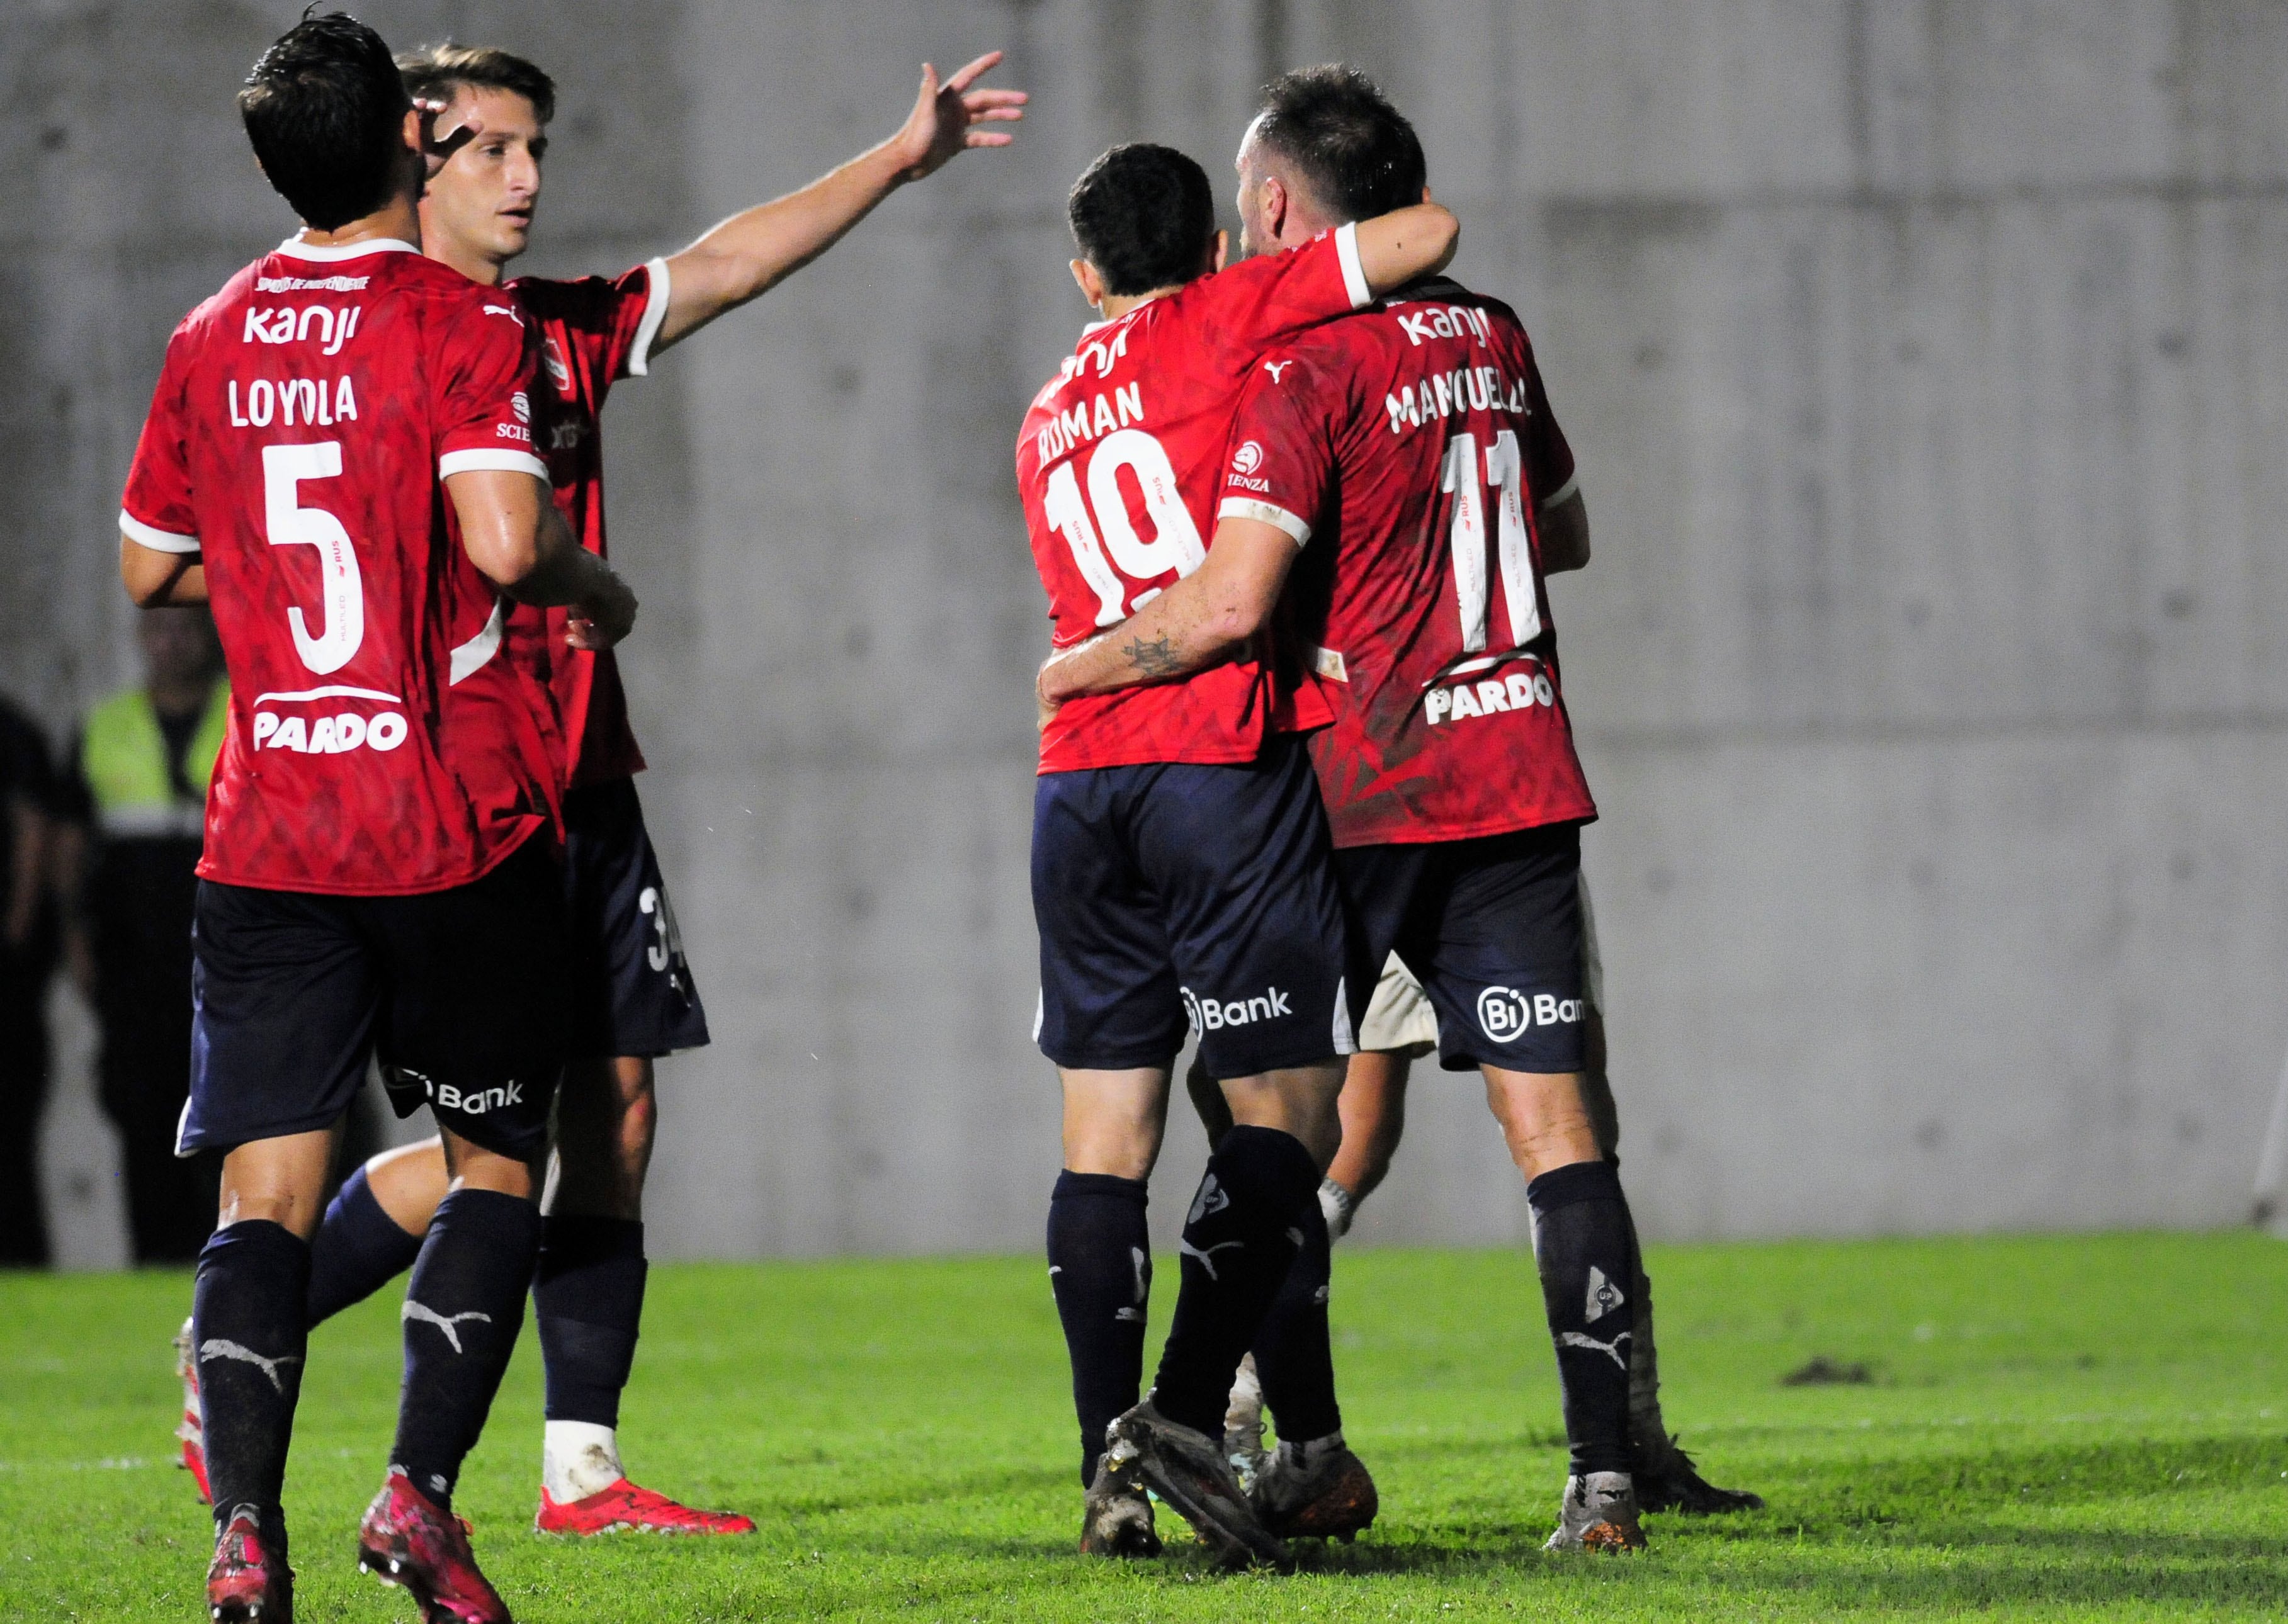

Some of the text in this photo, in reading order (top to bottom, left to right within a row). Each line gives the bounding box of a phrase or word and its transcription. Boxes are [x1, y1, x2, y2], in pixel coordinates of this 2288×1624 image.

[243, 305, 361, 356] kanji
[1397, 306, 1491, 347] kanji
[229, 375, 358, 427] LOYOLA
[496, 422, 531, 442] SCIE
[1038, 381, 1144, 466] ROMAN
[1228, 473, 1269, 492] IENZA
[1044, 429, 1206, 626] 19
[1461, 495, 1470, 517] RUS
[262, 441, 364, 675] 5
[332, 540, 343, 562] RUS
[1442, 430, 1541, 652] 11
[1425, 674, 1553, 725] PARDO
[254, 711, 407, 753] PARDO
[1201, 986, 1293, 1030] Bank
[1533, 994, 1585, 1026] Ban
[438, 1079, 523, 1114] Bank
